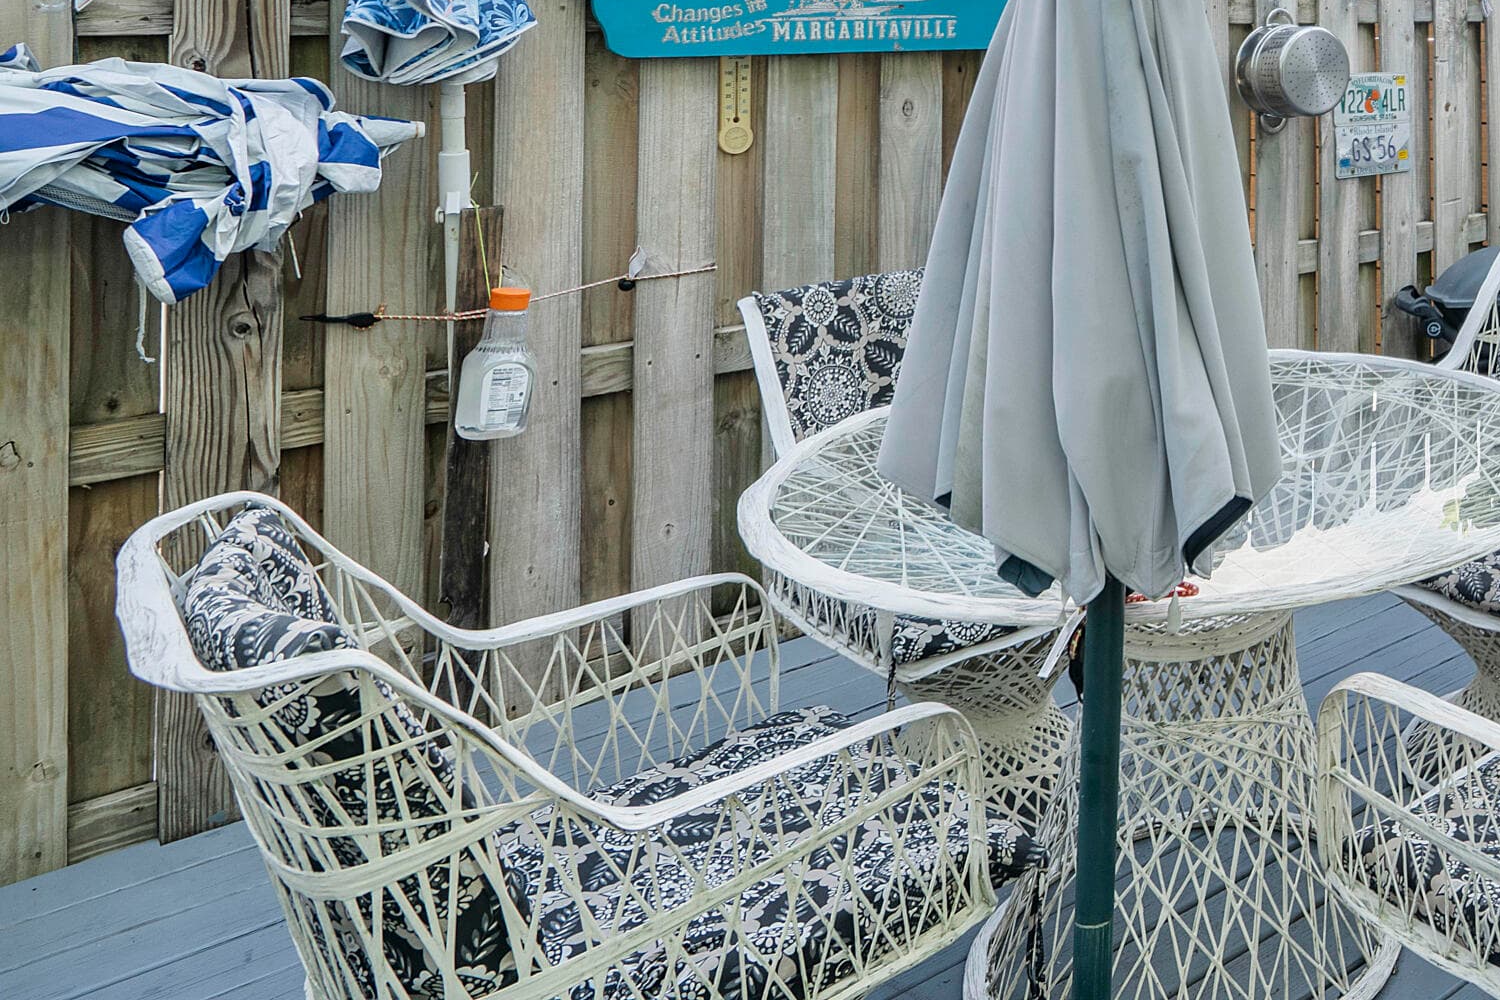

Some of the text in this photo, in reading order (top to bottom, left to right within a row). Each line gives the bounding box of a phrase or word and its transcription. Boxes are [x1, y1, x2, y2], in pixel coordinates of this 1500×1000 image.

[652, 3, 753, 24] Changes
[661, 20, 767, 44] Attitudes
[772, 19, 958, 42] MARGARITAVILLE
[1381, 88, 1406, 112] 4LR
